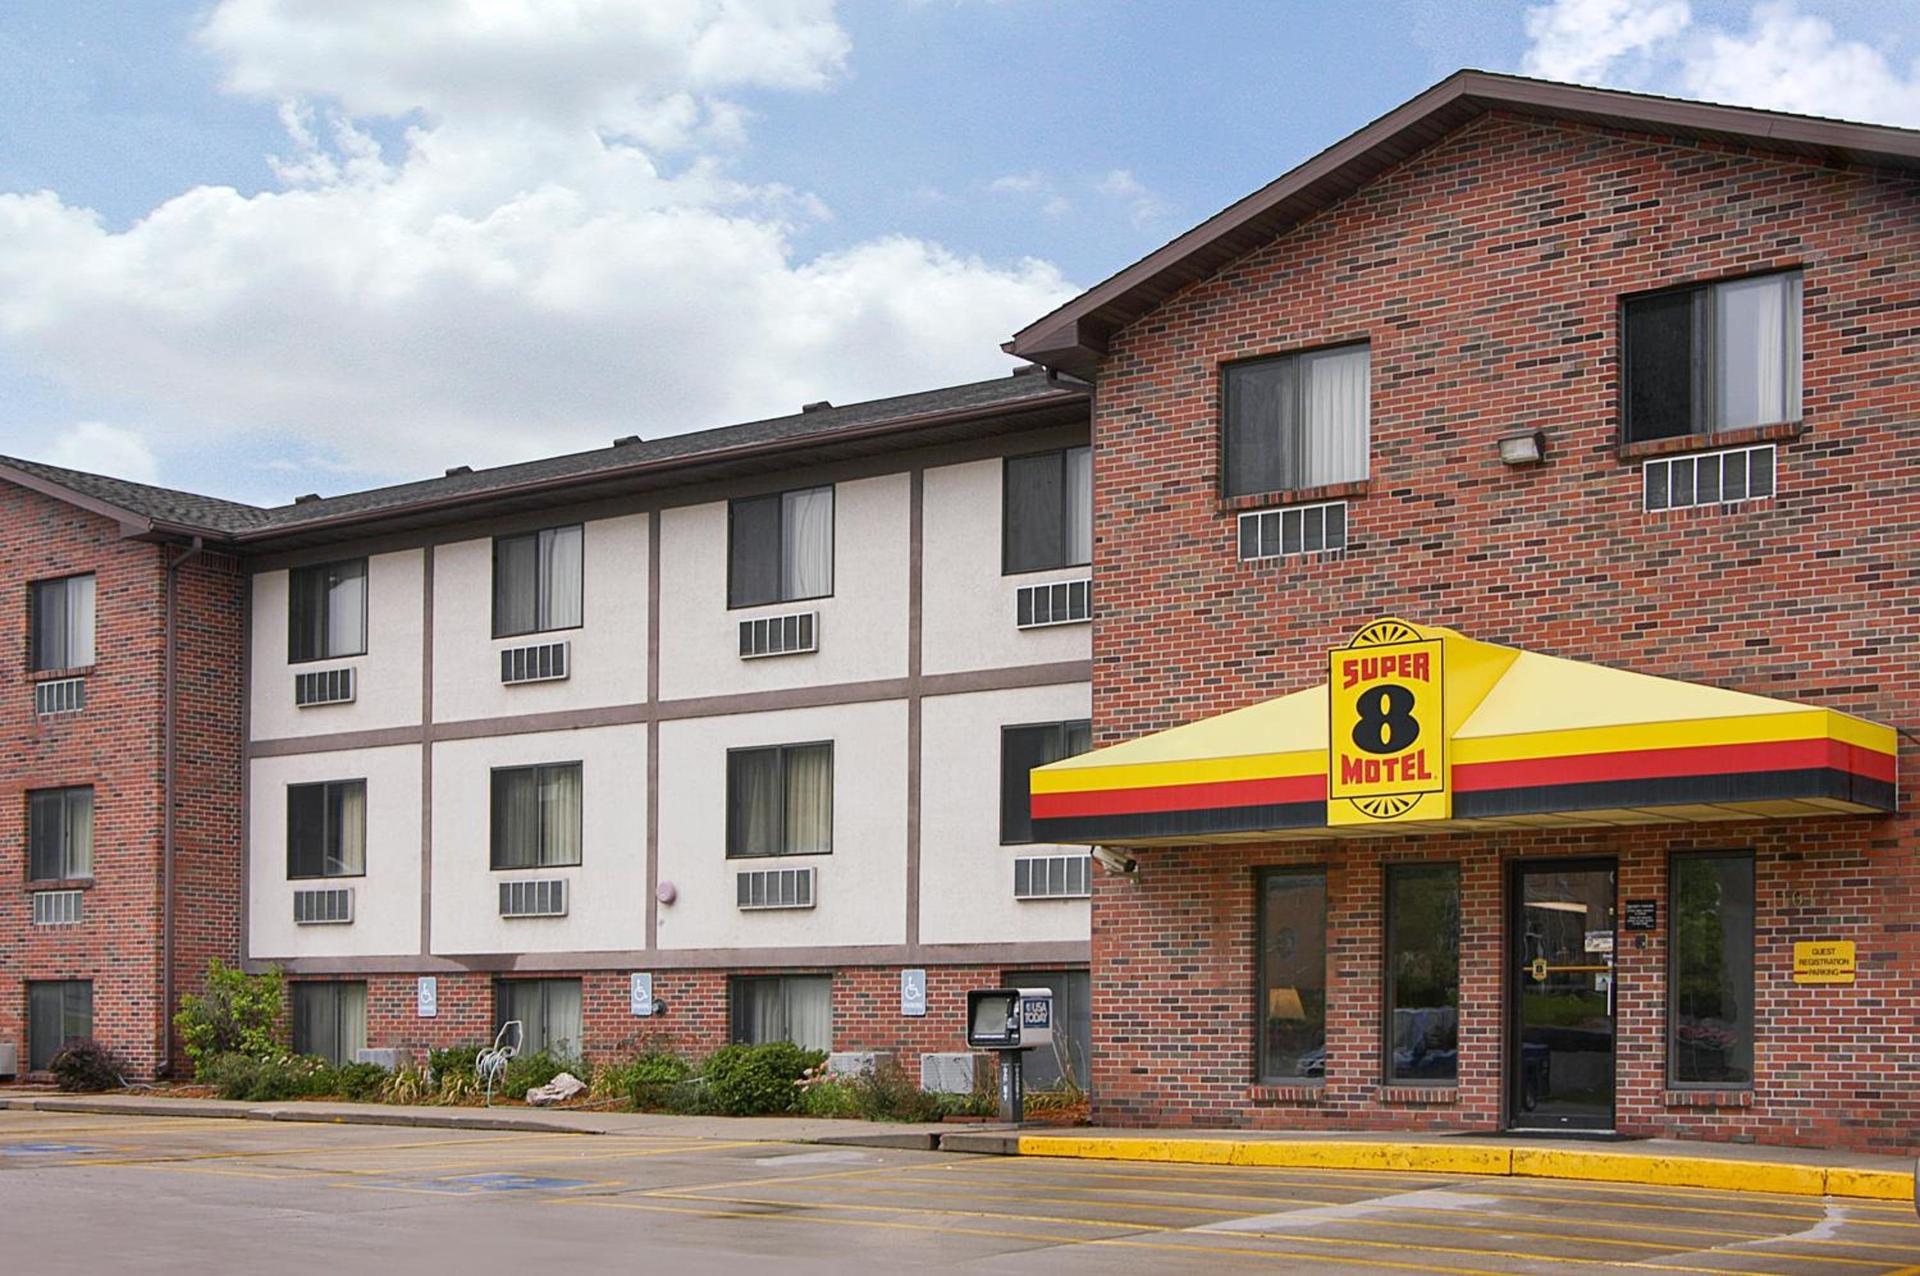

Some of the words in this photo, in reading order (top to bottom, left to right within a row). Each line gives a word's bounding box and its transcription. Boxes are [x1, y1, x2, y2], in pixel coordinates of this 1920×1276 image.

[1343, 652, 1429, 690] SUPER
[1352, 684, 1420, 754] 8
[1341, 749, 1431, 785] MOTEL
[1811, 947, 1835, 955] GUEST
[1798, 958, 1849, 966] REGISTRATION
[1808, 968, 1839, 976] PARKING
[1032, 1002, 1047, 1012] USA
[1024, 1012, 1048, 1023] TODAY
